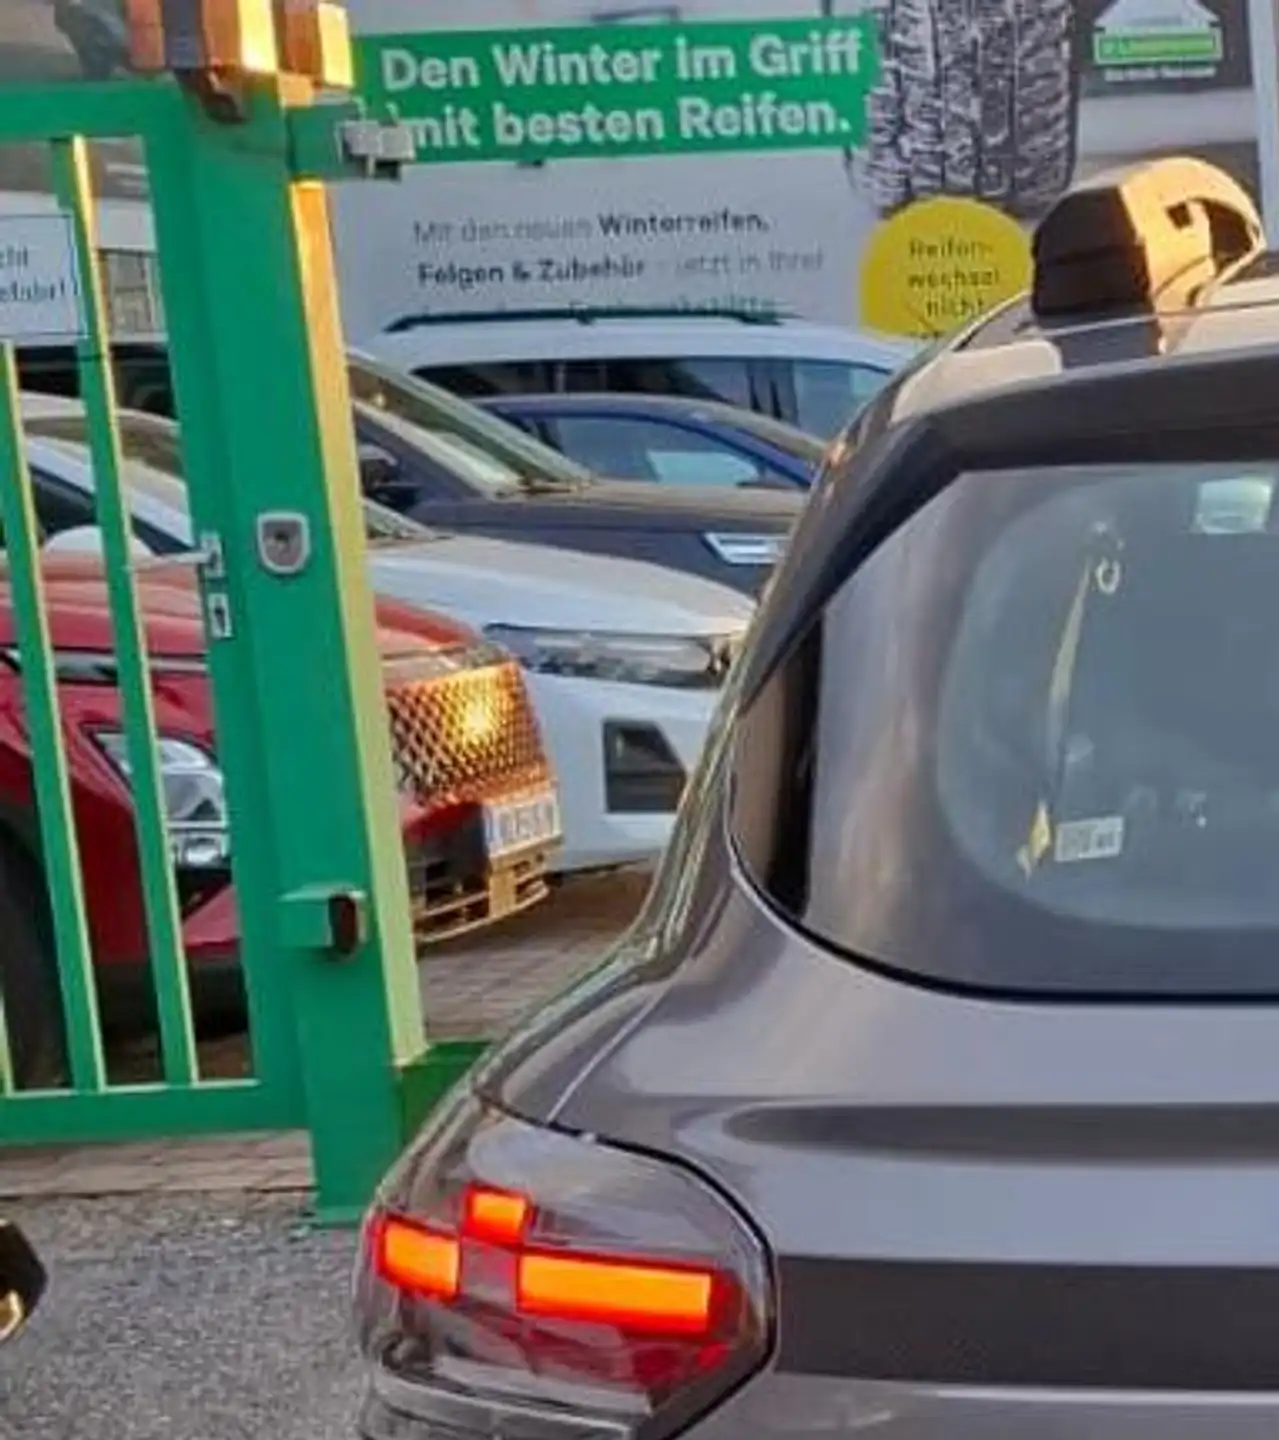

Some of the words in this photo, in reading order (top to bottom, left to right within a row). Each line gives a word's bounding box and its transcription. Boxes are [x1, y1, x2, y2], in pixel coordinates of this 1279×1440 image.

[380, 47, 480, 90] Den
[491, 40, 663, 87] Winter
[676, 35, 736, 78] im
[749, 27, 864, 76] Griff
[493, 101, 665, 145] besten
[678, 92, 851, 143] Reifen.
[416, 260, 504, 290] Felgen
